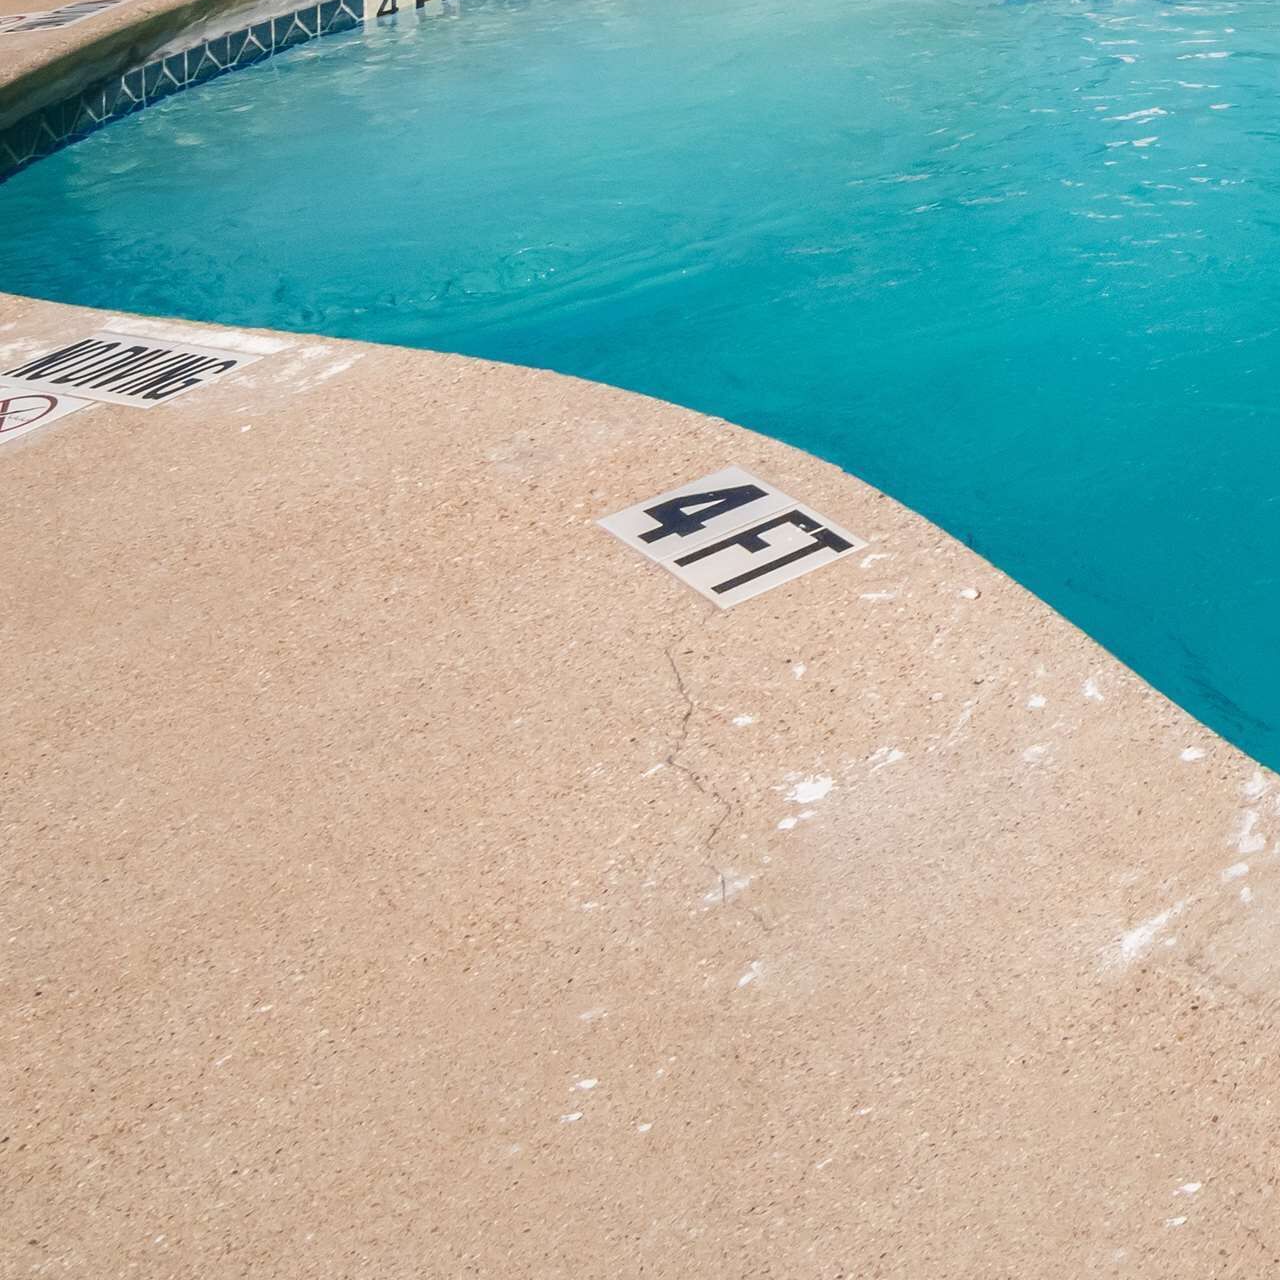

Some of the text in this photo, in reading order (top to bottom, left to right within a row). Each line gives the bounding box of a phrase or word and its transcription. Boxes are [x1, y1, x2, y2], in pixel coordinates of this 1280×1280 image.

[1, 339, 238, 400] NO DIVING
[638, 484, 855, 594] 4 FT
